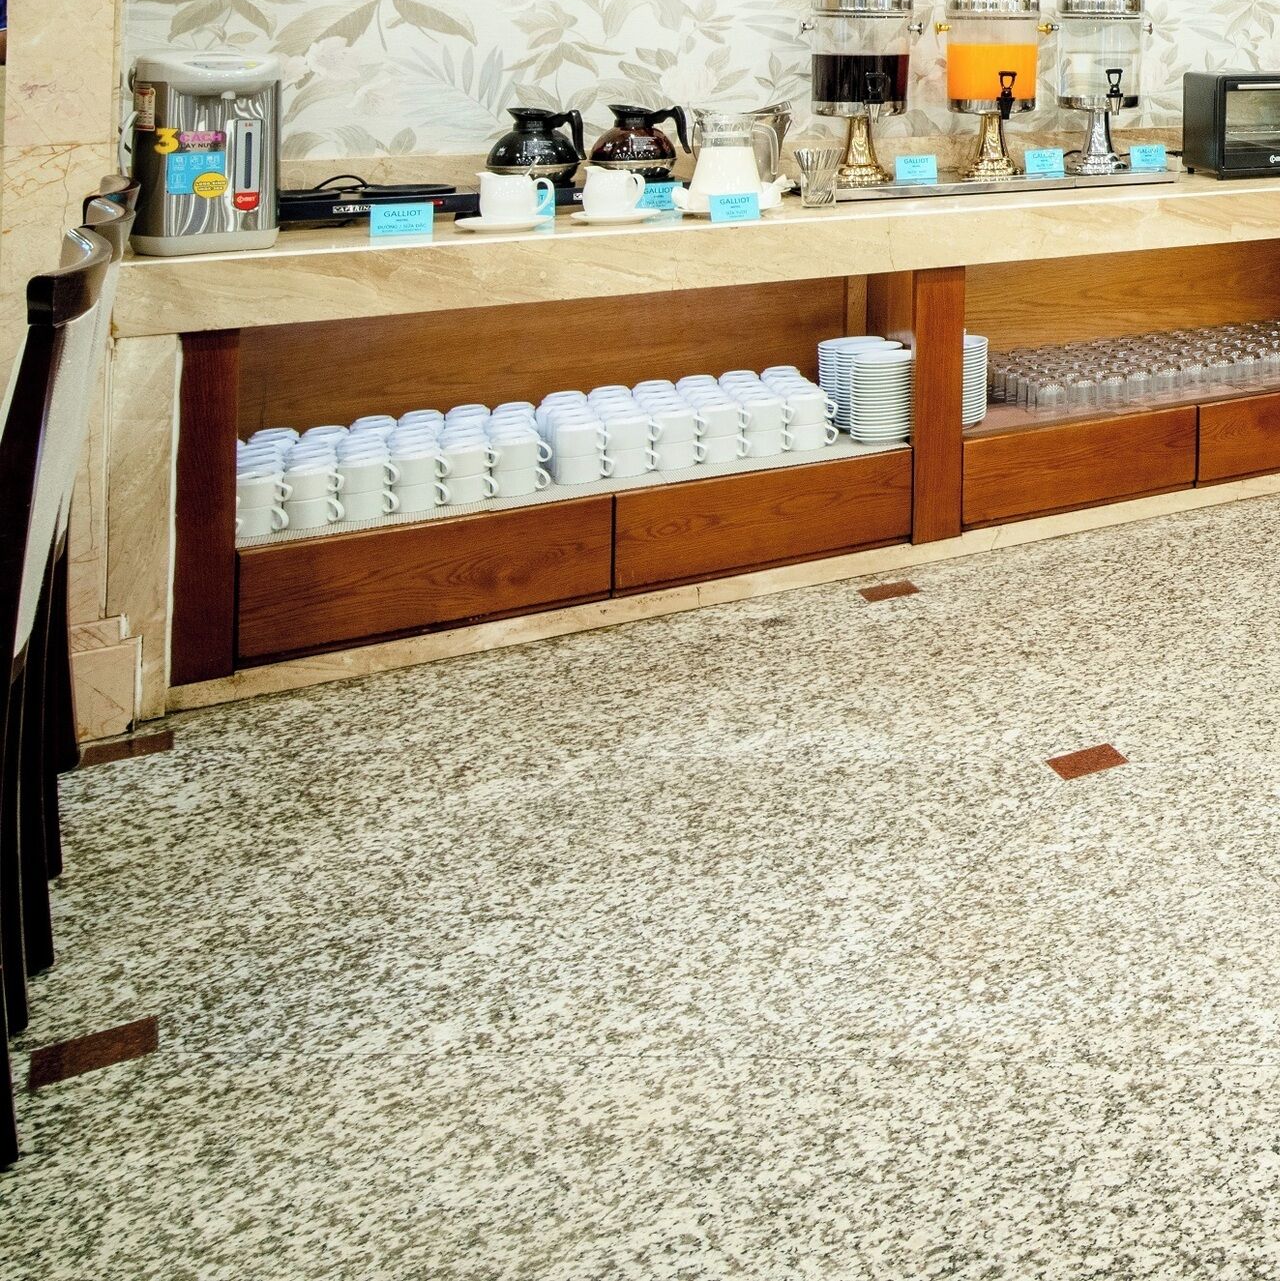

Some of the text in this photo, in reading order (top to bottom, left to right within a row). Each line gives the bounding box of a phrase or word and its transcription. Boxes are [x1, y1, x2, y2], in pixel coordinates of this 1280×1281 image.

[154, 128, 179, 154] 3
[720, 197, 750, 205] GALLIOT
[383, 210, 423, 218] GALLIOT
